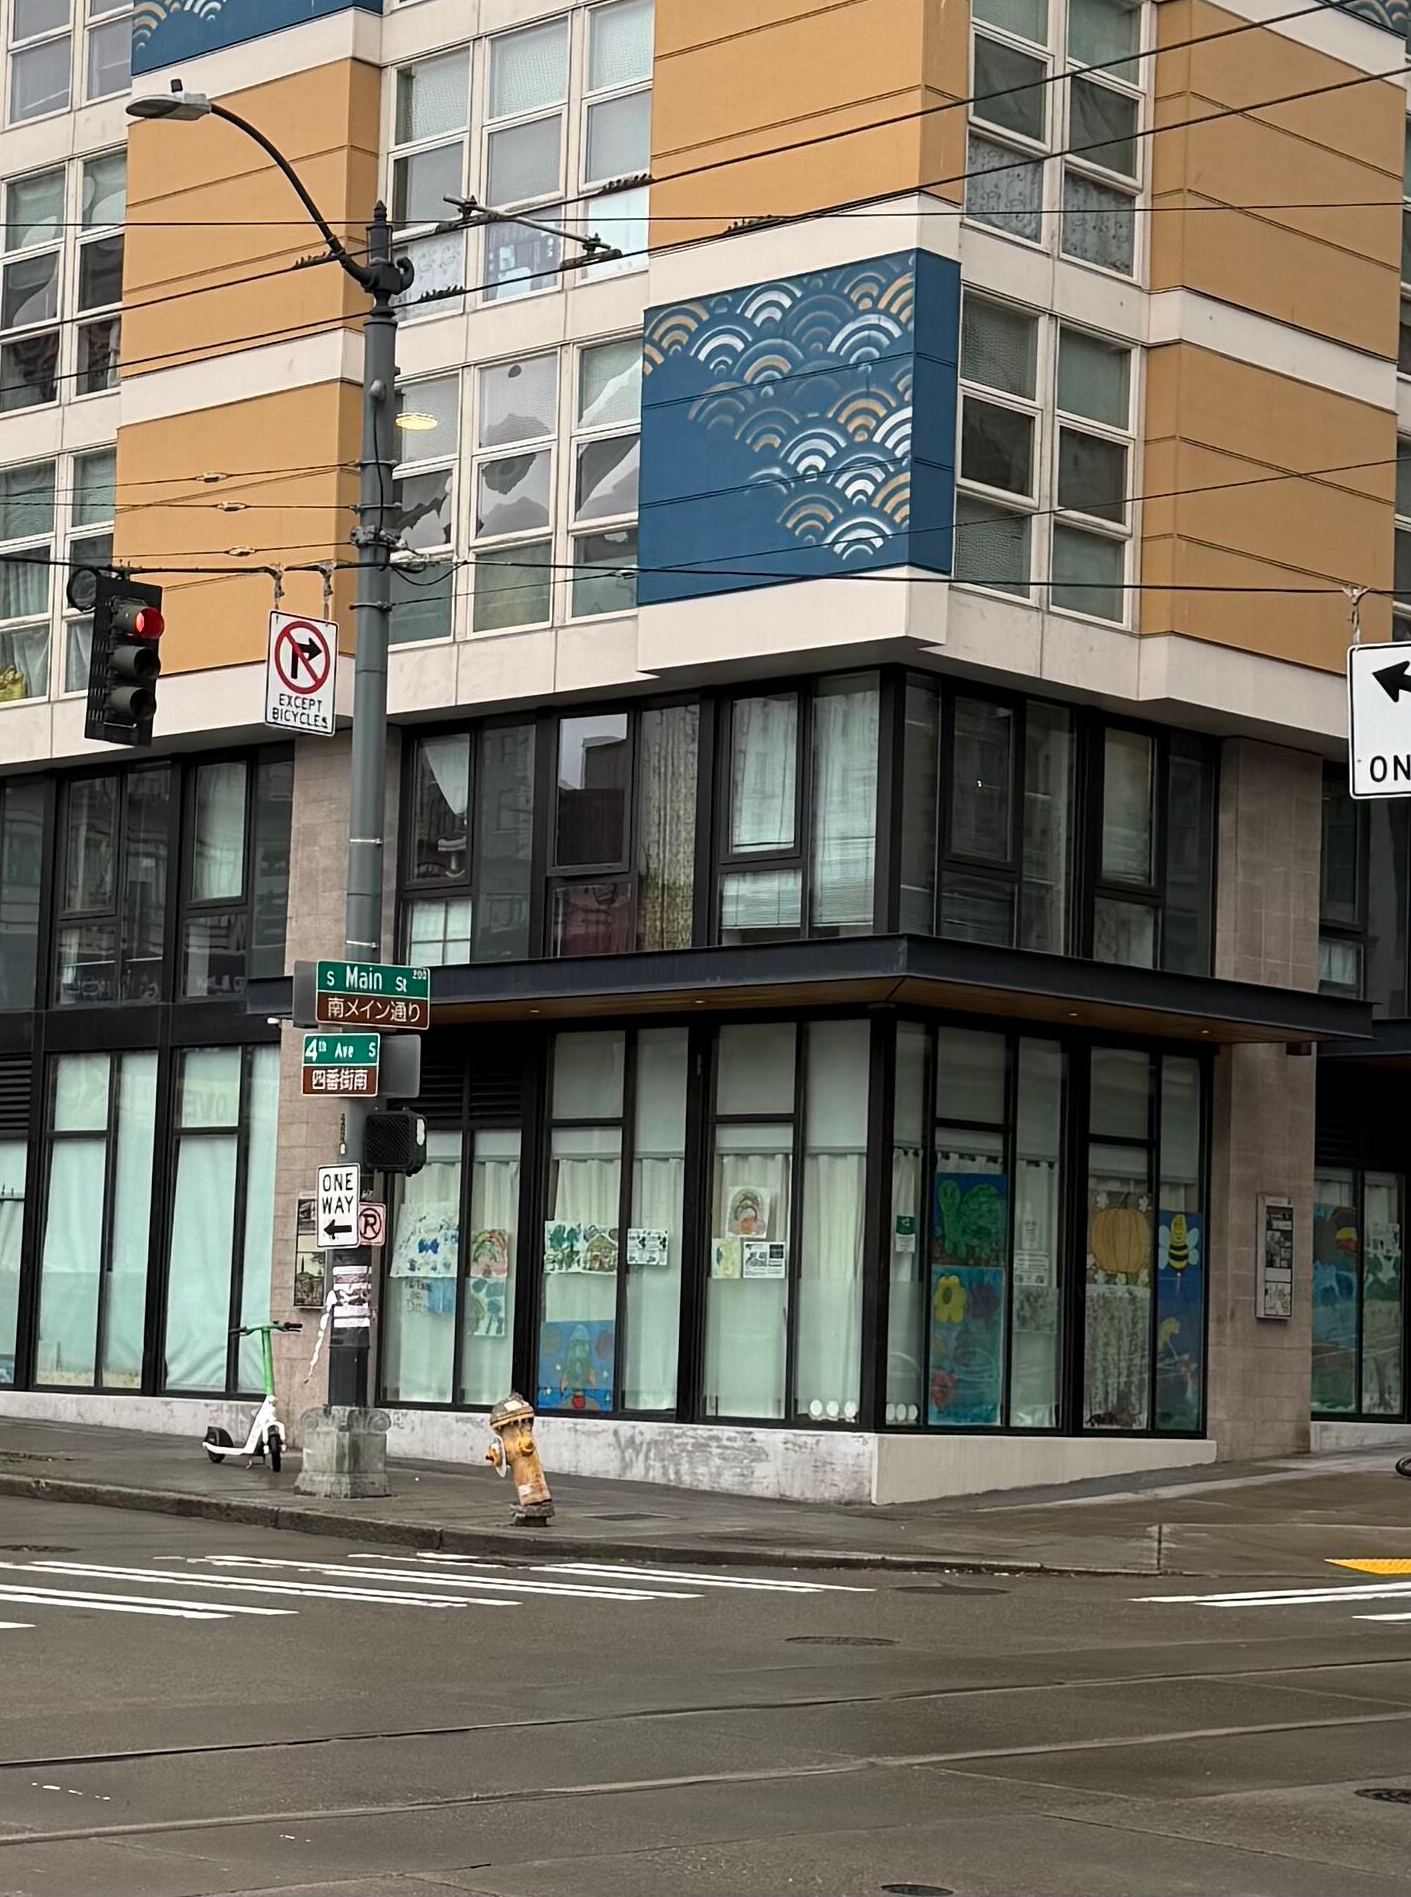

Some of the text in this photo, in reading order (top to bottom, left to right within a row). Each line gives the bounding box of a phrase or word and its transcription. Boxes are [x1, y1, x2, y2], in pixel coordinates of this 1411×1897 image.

[279, 693, 322, 713] EXCEPT
[272, 707, 328, 729] BICYCLES
[327, 970, 335, 986] S
[345, 966, 383, 990] Main
[395, 976, 407, 992] St
[328, 997, 421, 1022] 南メイン通り
[335, 1042, 354, 1058] Ave
[368, 1042, 376, 1057] S
[312, 1068, 368, 1091] 四番街南
[322, 1172, 354, 1192] ONE
[322, 1195, 354, 1214] WAY
